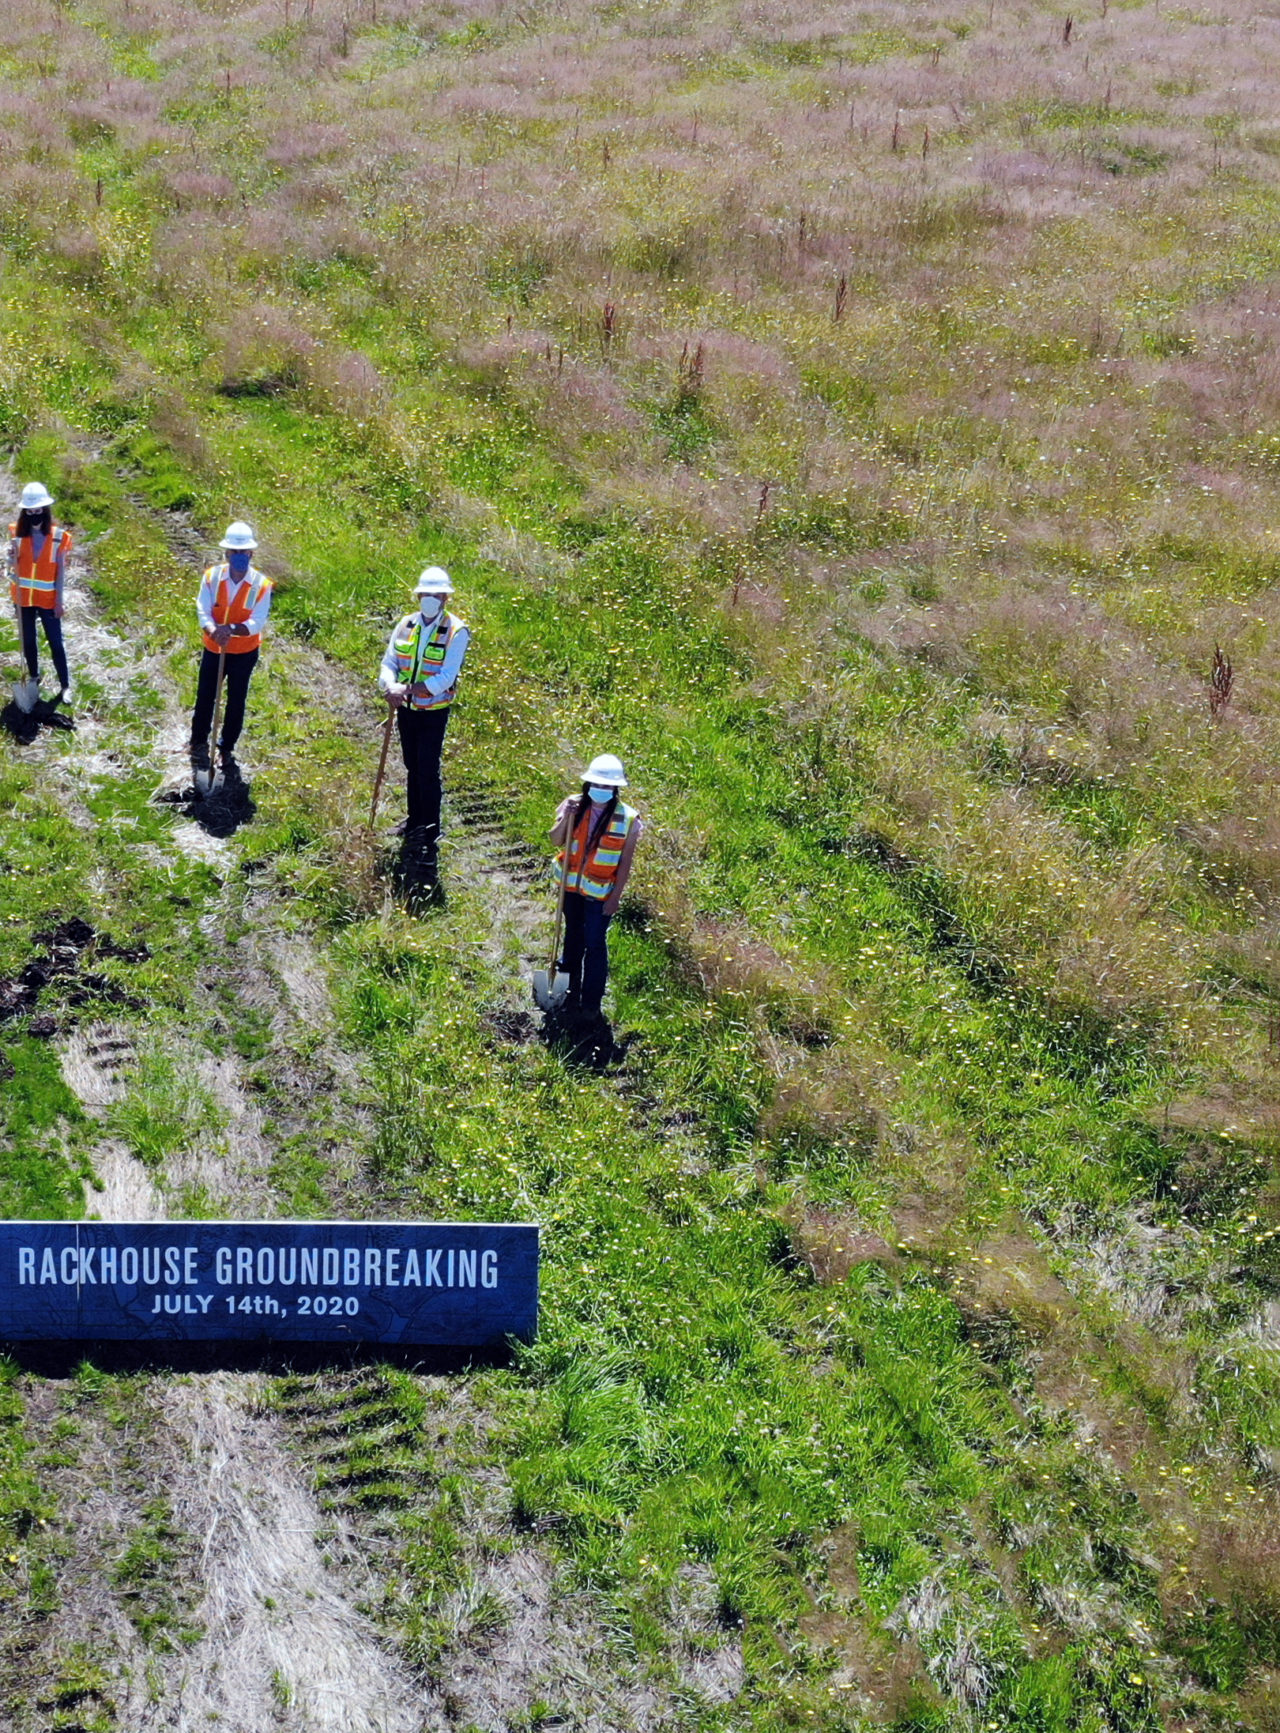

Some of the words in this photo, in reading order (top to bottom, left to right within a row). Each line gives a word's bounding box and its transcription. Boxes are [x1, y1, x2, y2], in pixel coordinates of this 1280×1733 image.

[19, 1247, 199, 1285] RACKHOUSE
[216, 1247, 498, 1289] GROUNDBREAKING
[151, 1294, 214, 1314] JULY
[225, 1295, 287, 1318] 14th,
[297, 1296, 359, 1316] 2020
